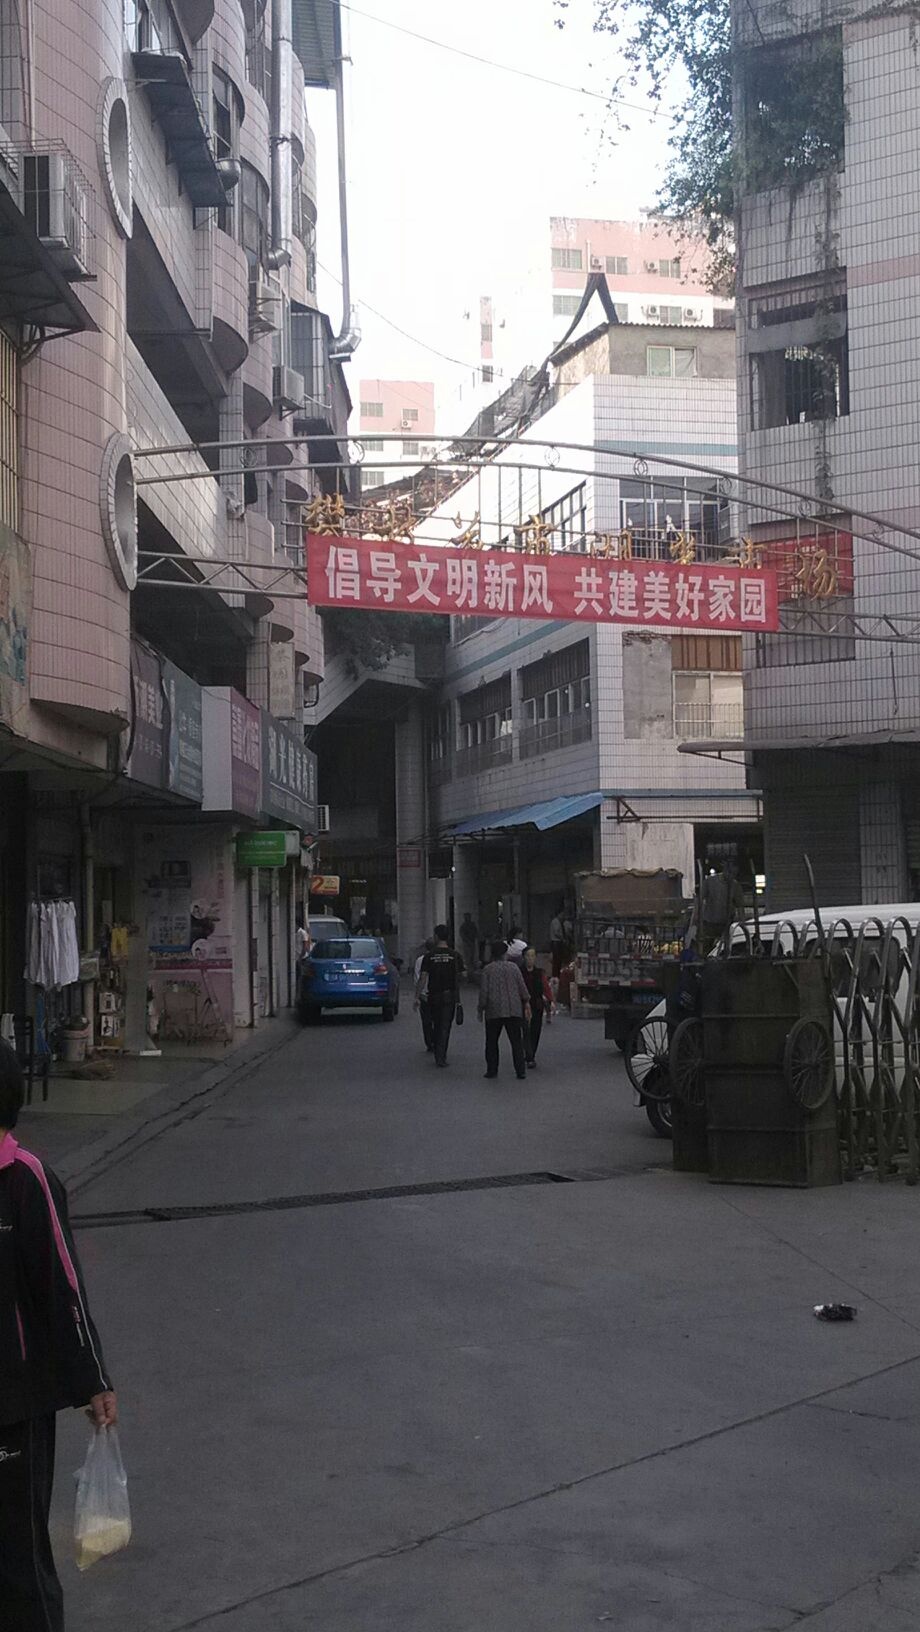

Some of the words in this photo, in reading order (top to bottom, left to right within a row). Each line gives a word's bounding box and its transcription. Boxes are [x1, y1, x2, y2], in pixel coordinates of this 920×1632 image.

[326, 545, 553, 615] 倡导文明新风
[574, 565, 767, 624] 共建美好家园
